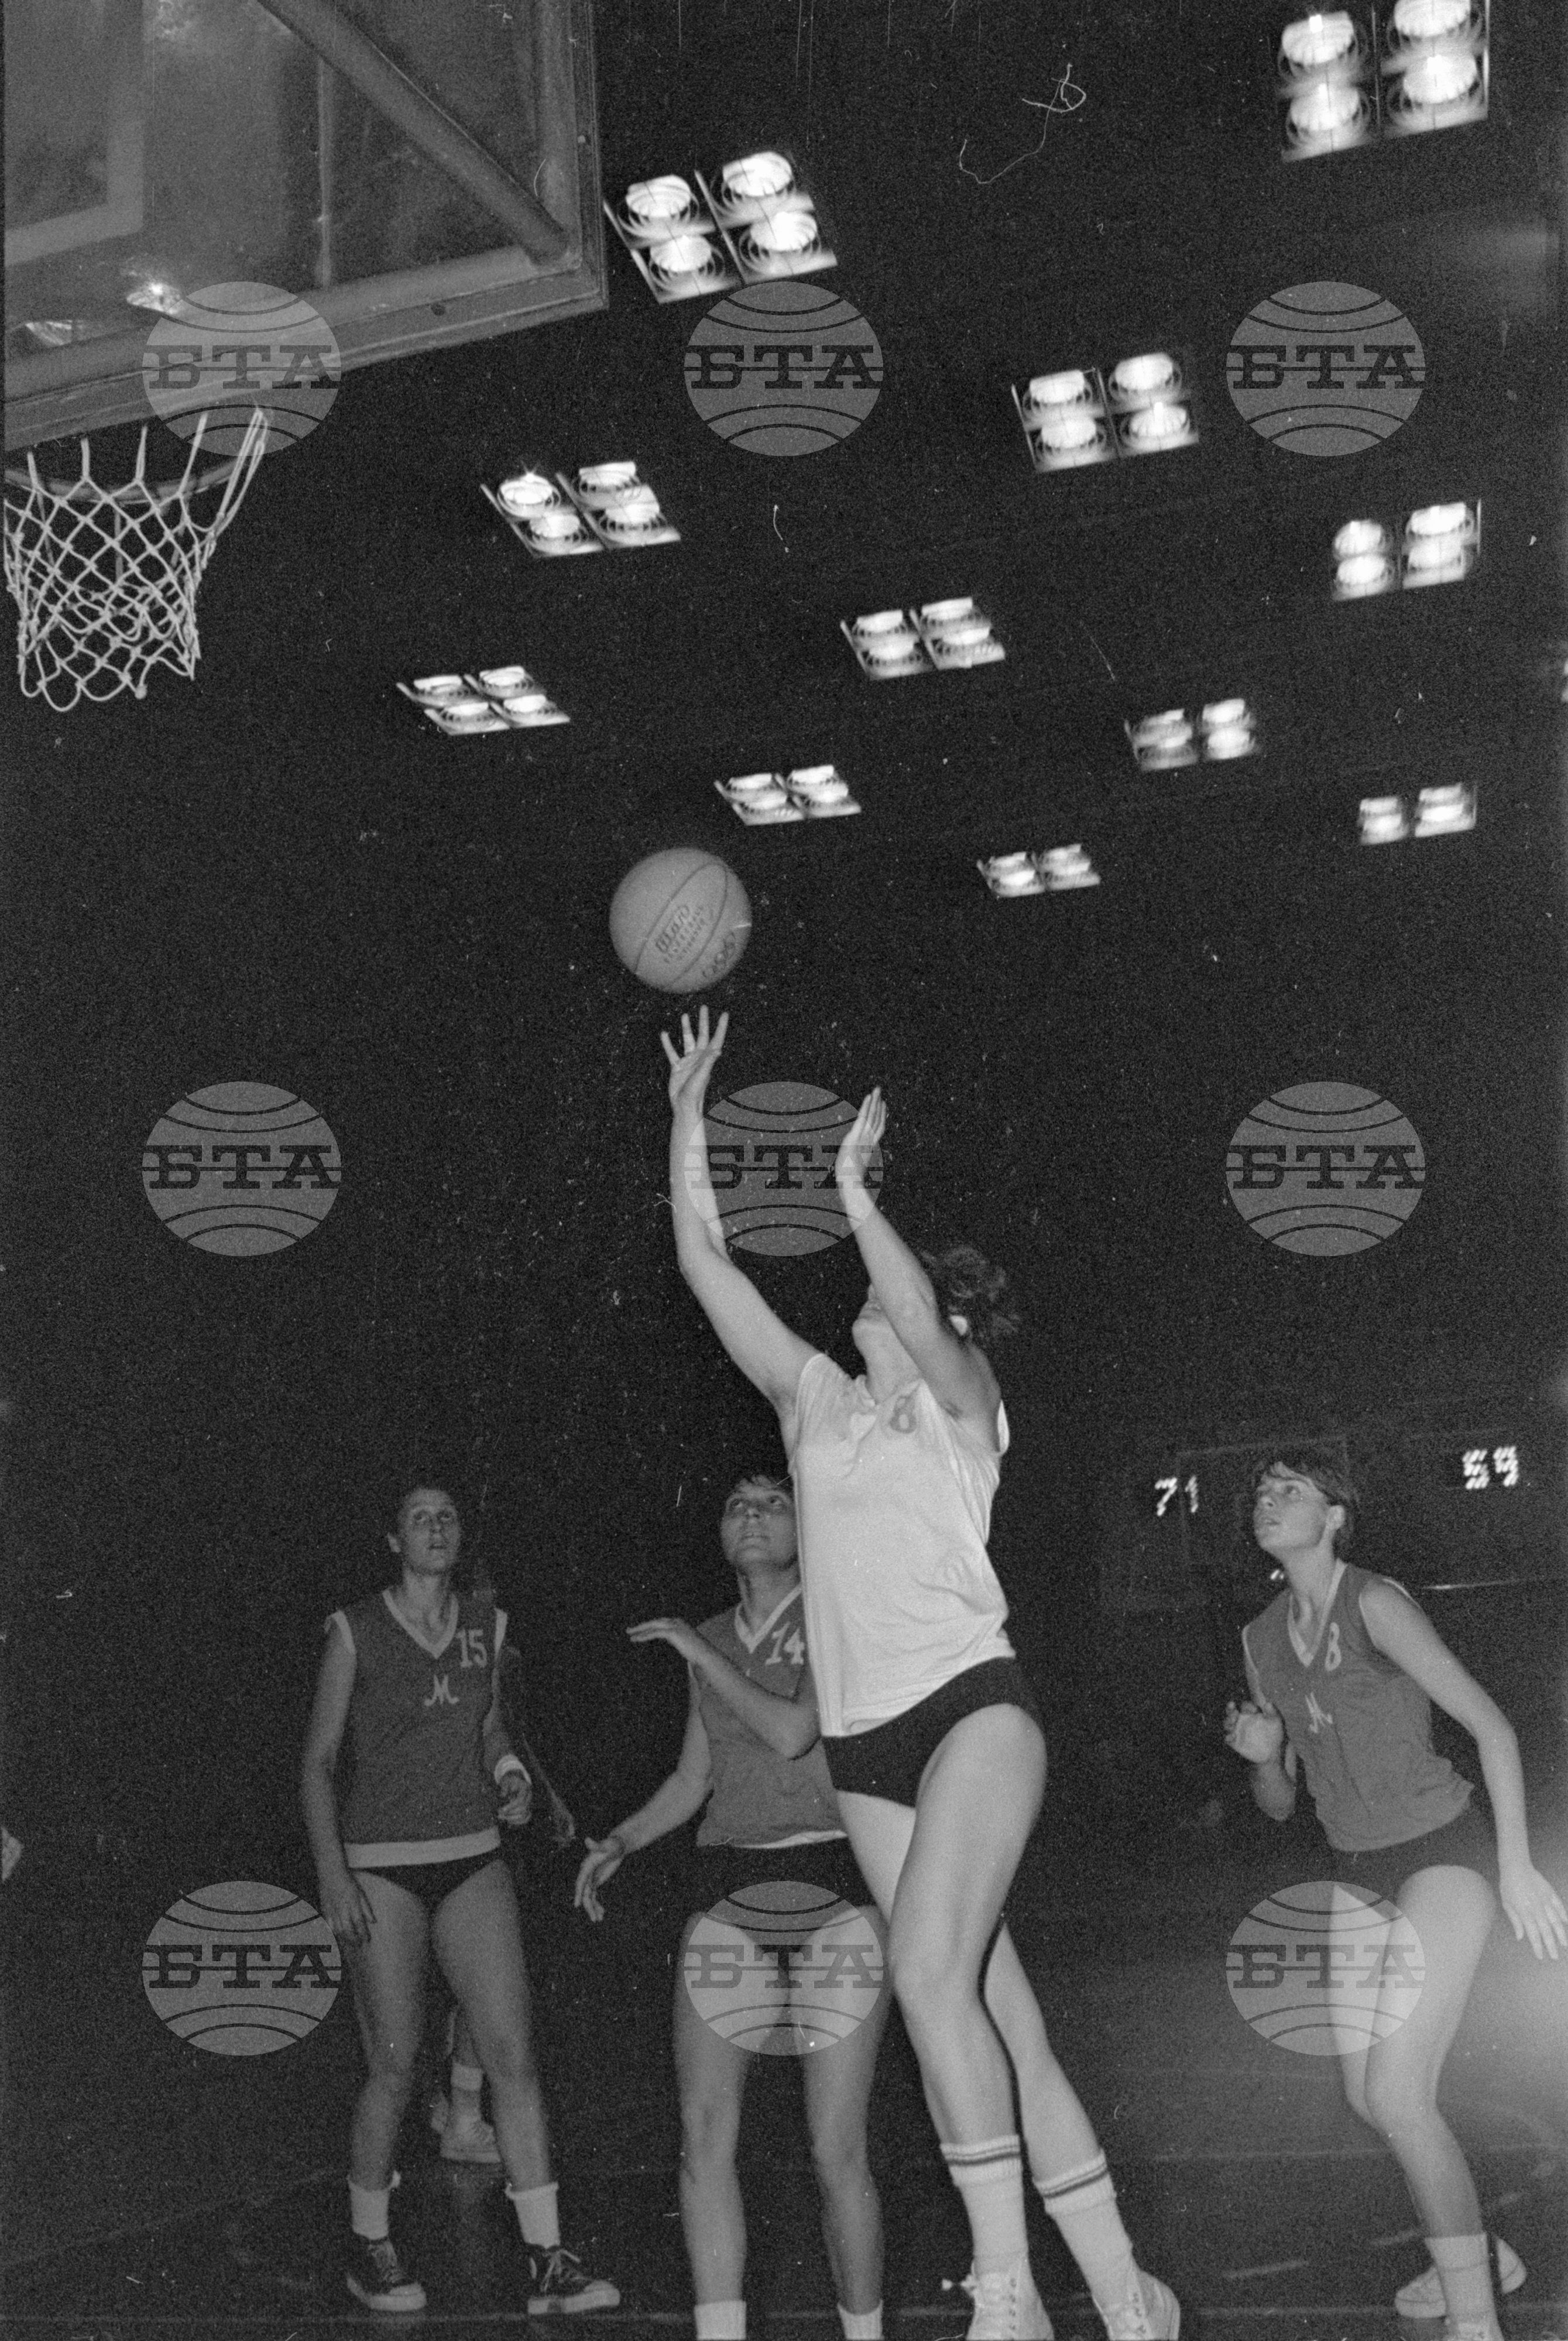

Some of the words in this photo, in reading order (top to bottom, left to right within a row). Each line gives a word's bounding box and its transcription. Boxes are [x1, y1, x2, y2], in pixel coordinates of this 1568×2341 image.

[1462, 1446, 1519, 1489] 59
[1155, 1475, 1199, 1516] 71
[455, 1628, 488, 1668] 15
[765, 1621, 805, 1666] 14
[1325, 1622, 1341, 1671] 8
